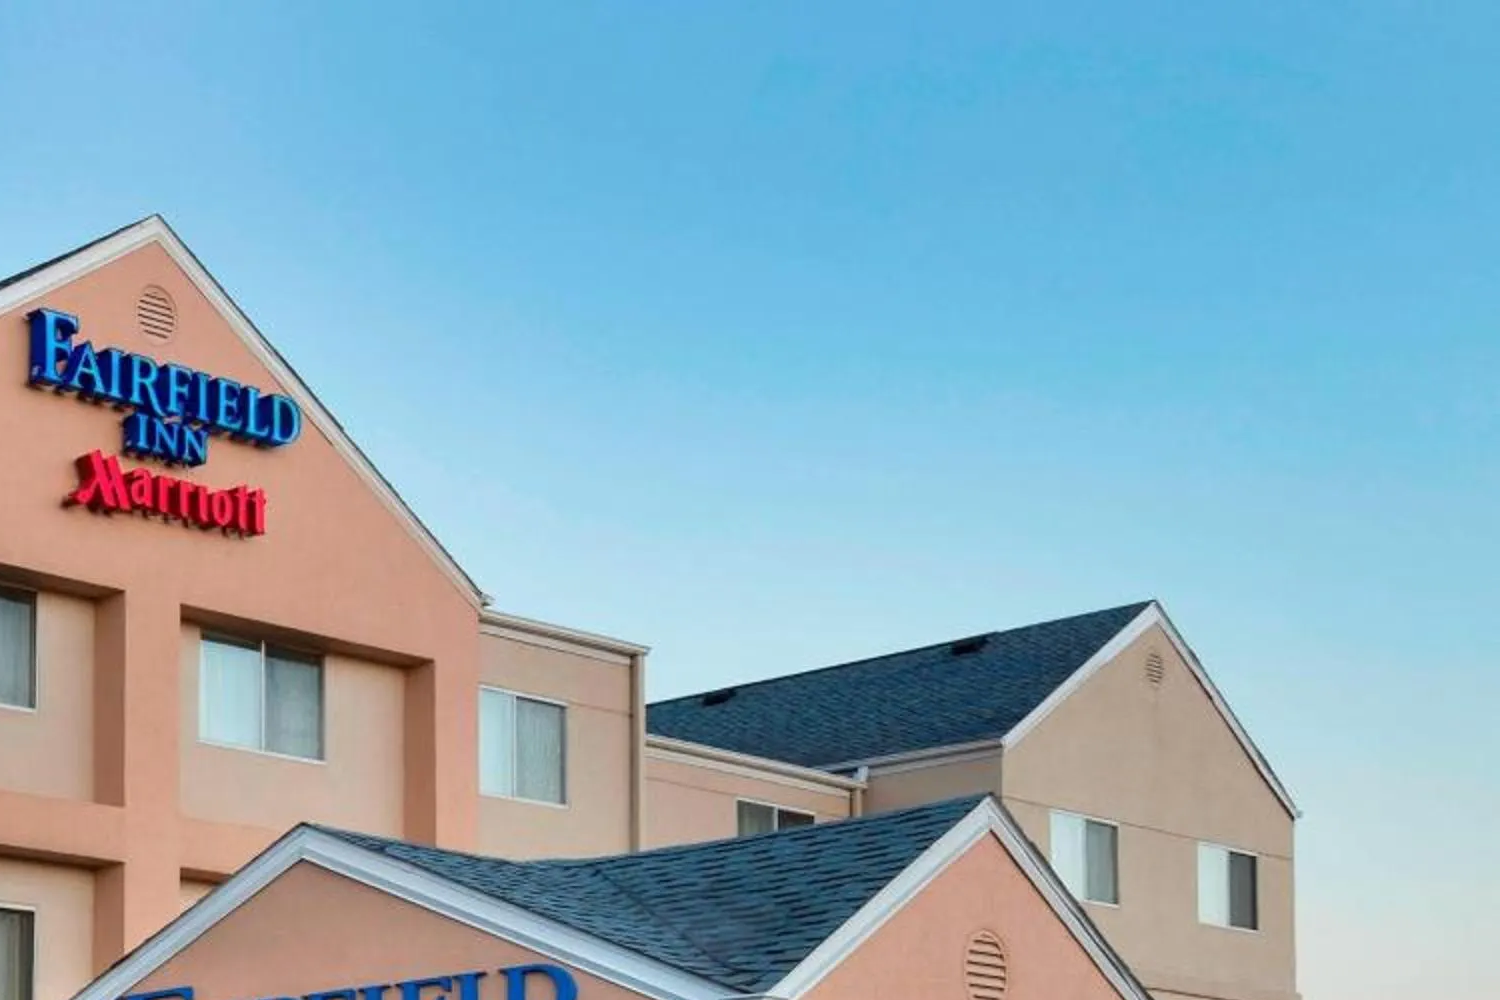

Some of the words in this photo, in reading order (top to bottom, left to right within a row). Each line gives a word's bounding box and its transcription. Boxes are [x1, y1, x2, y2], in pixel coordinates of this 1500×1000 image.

[26, 308, 302, 446] FAIRFIELD
[123, 412, 208, 467] INN
[64, 449, 267, 536] Marriott
